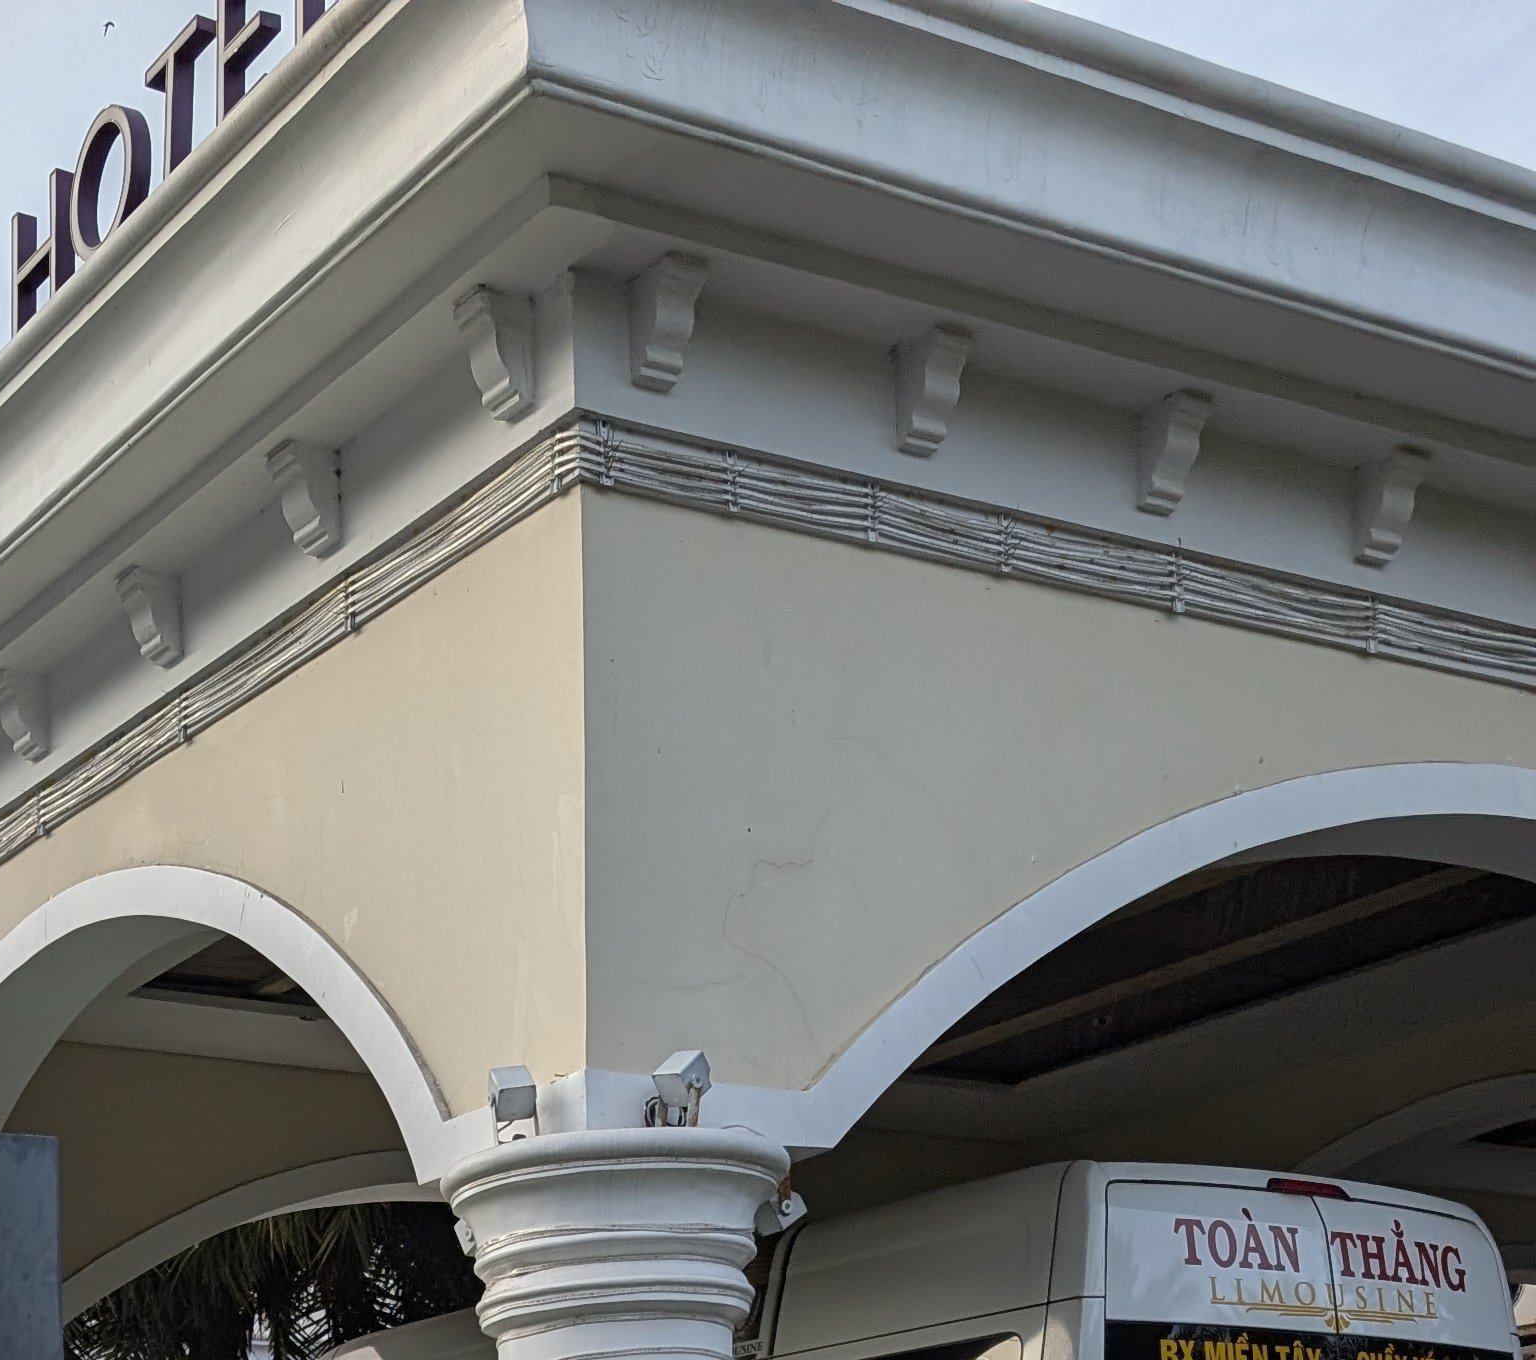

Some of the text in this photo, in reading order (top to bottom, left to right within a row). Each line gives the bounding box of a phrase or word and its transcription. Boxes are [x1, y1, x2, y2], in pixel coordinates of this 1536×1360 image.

[11, 0, 335, 338] HOTE
[1173, 1207, 1301, 1273] TOÀN
[1208, 1276, 1437, 1316] LIMOUSINE
